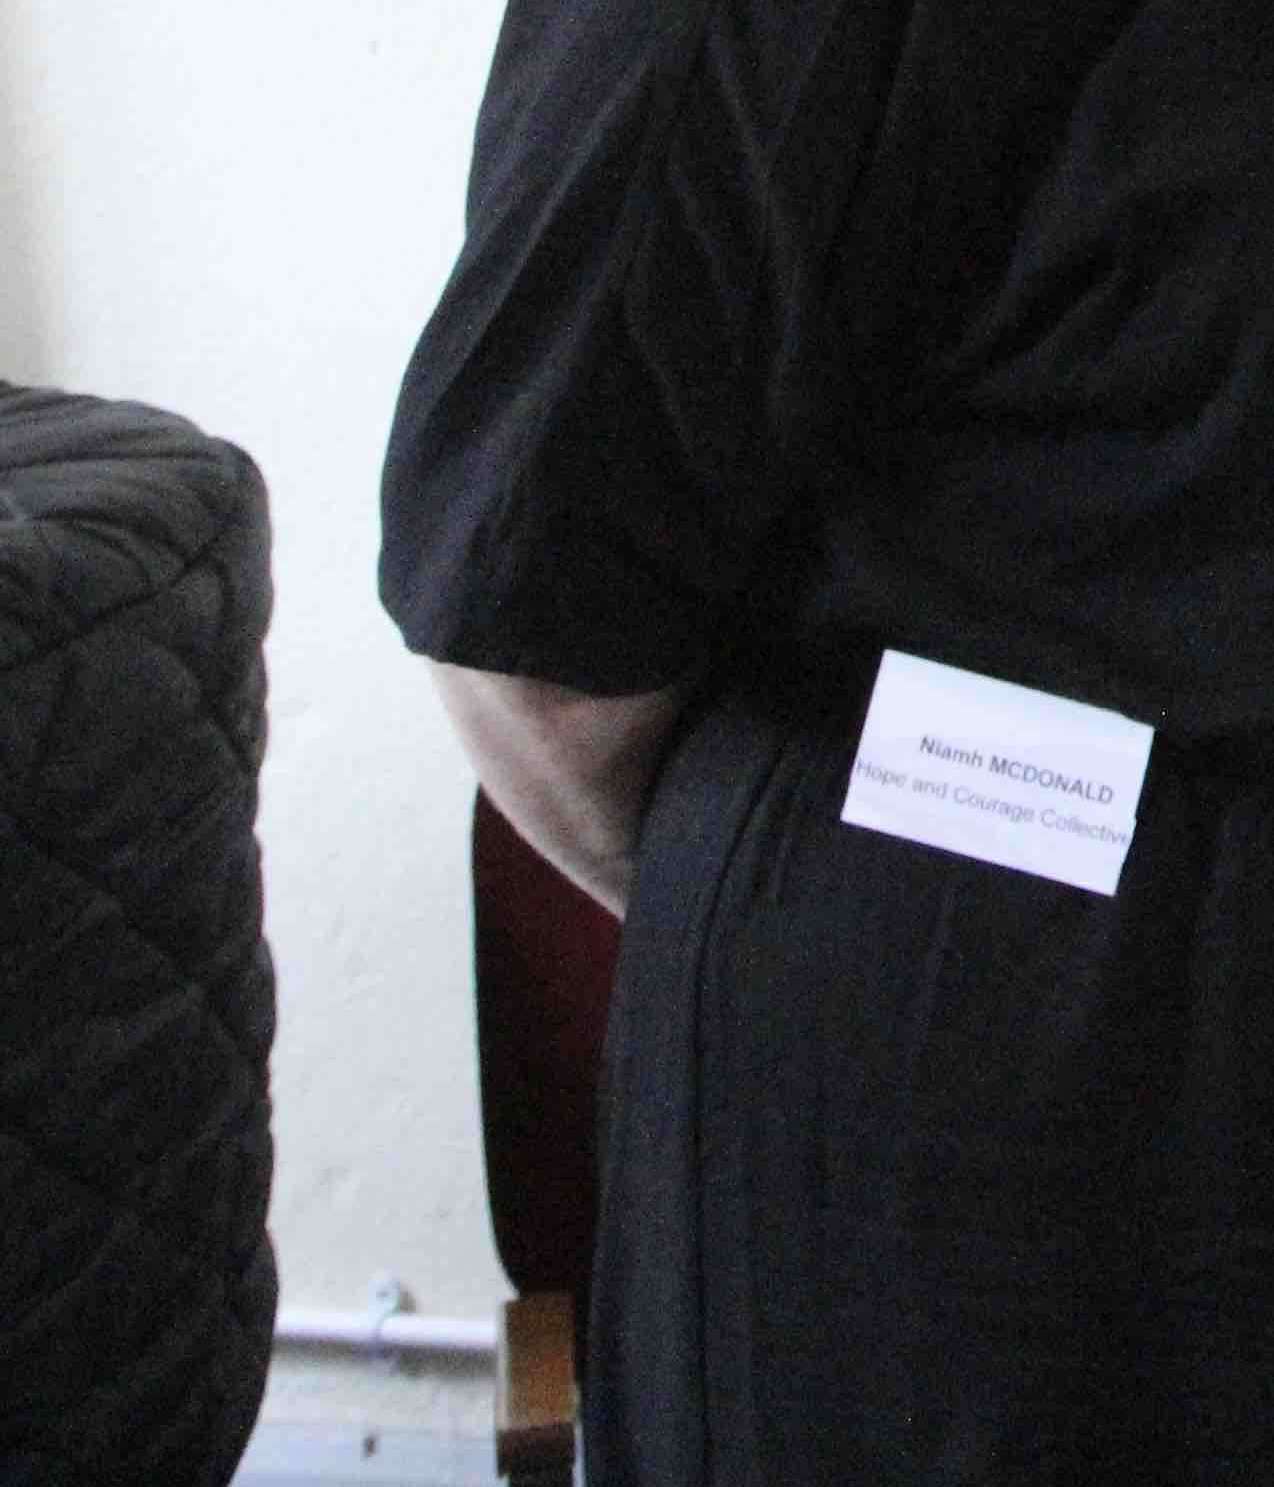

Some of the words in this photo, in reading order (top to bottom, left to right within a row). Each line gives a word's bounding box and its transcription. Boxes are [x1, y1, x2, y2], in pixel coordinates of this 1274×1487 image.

[855, 758, 908, 789] Hope
[911, 774, 948, 801] and
[953, 784, 1036, 824] Courage
[919, 735, 984, 769] Niamh
[988, 754, 1115, 805] MCDONALD
